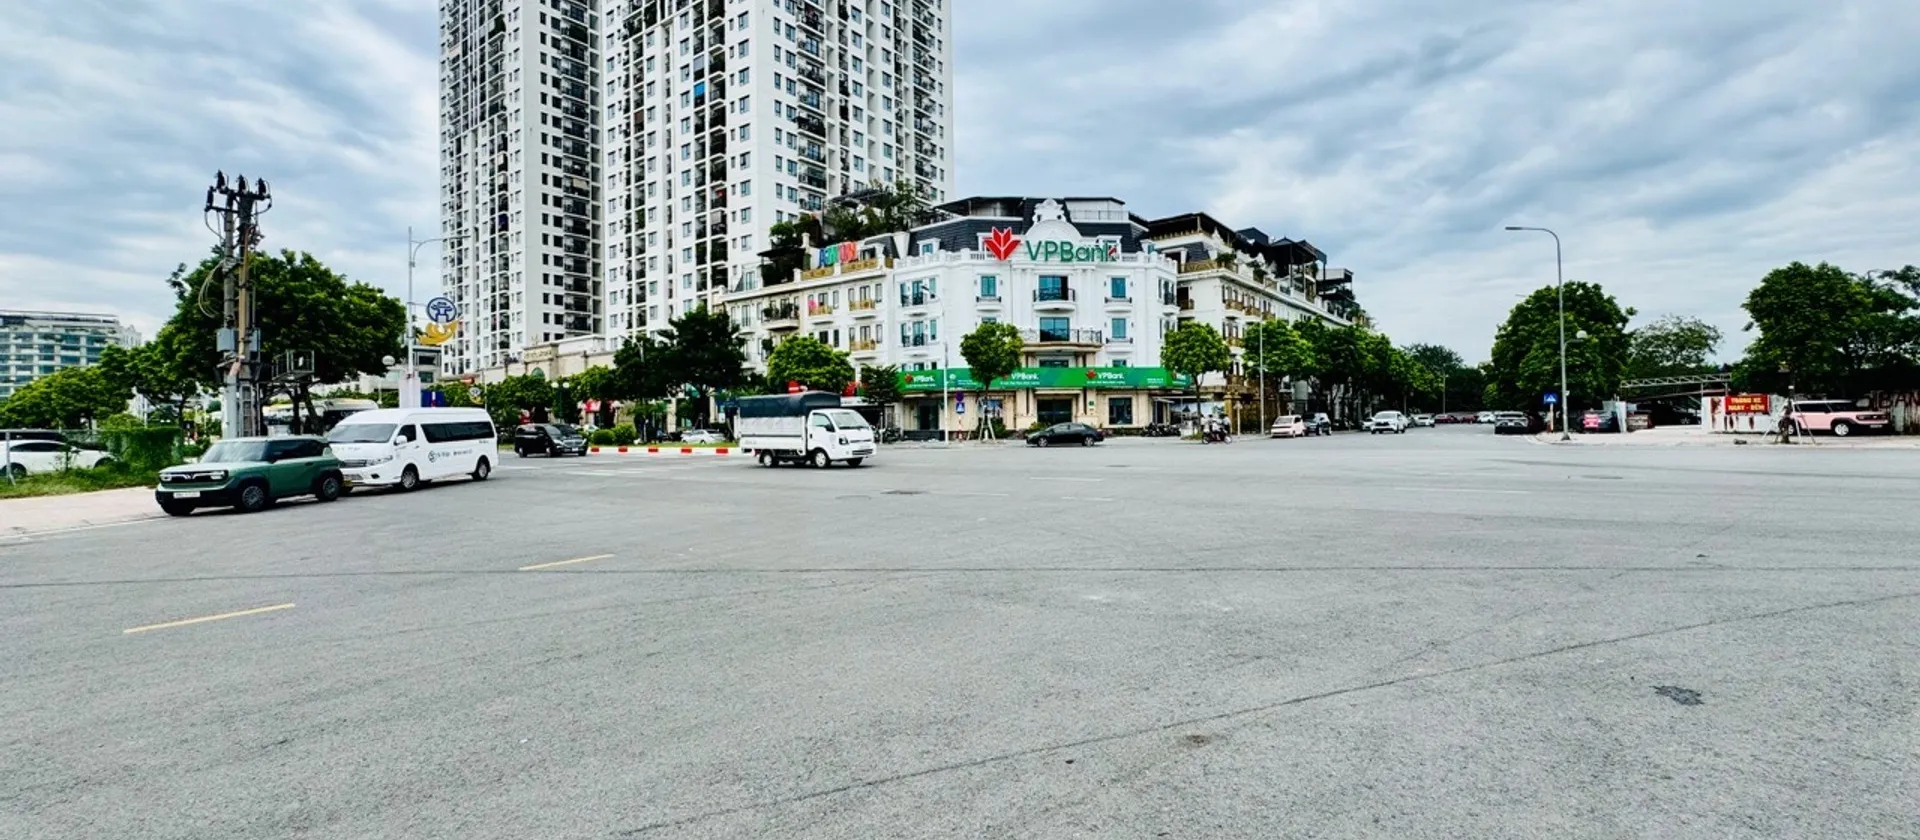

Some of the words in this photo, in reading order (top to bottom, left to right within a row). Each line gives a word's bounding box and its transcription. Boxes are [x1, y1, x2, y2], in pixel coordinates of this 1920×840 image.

[1026, 240, 1117, 262] VPBank
[1011, 372, 1039, 380] VPBank
[1097, 372, 1124, 380] VPBank
